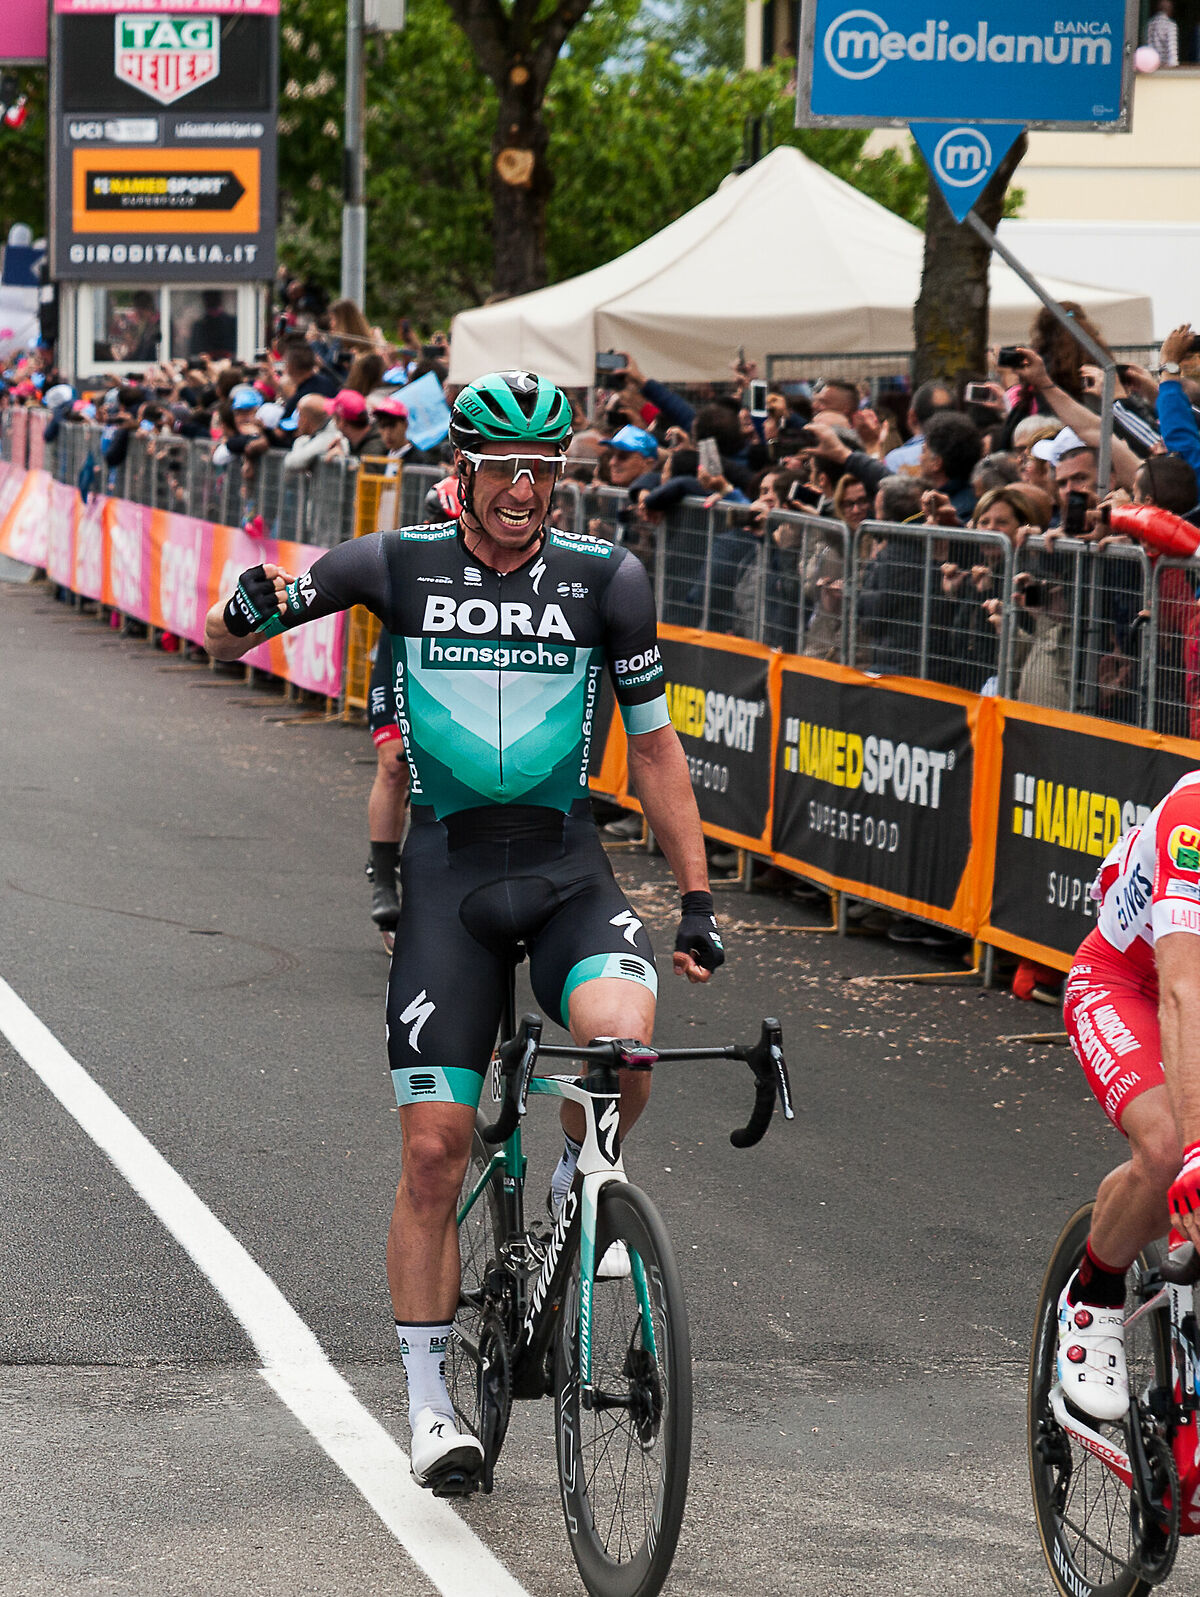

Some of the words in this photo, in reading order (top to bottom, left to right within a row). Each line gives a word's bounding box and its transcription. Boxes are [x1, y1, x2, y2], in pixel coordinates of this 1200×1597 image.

[124, 21, 211, 48] TAG
[833, 19, 1112, 68] mediolanum
[1054, 20, 1112, 36] BANCA
[122, 55, 212, 93] HEUER
[69, 243, 259, 264] GIRODITALIA.IT
[403, 527, 456, 541] hansgrohe
[552, 535, 610, 555] hansgrohe
[422, 594, 577, 642] BORA
[429, 637, 569, 668] hansgrohe
[614, 644, 662, 674] BORA
[371, 685, 386, 716] UAE
[393, 661, 424, 794] hansgrohe
[579, 665, 603, 787] hansgrohe
[808, 799, 900, 853] SUPERFOOD
[1076, 1011, 1121, 1086] GIOCATTOLI
[1092, 1003, 1142, 1057] ANDRONI
[524, 1191, 578, 1346] S-WORKS
